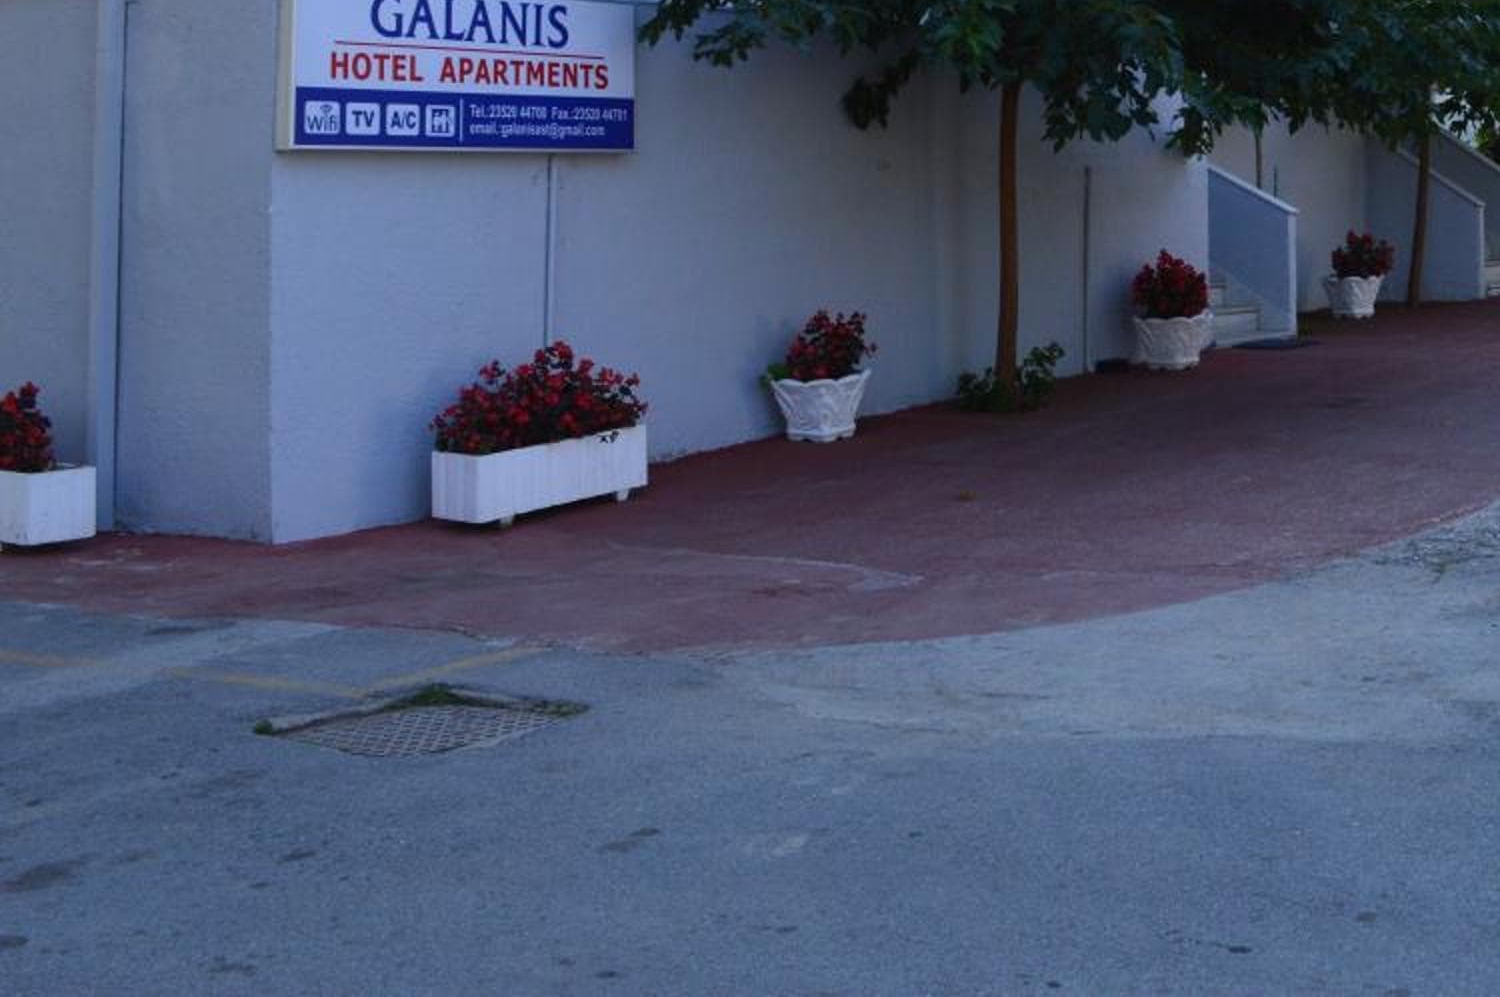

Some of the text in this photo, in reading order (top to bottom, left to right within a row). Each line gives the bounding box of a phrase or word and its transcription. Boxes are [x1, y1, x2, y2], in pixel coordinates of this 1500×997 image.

[330, 52, 609, 90] HOTEL APARTMENTS
[352, 110, 375, 128] TV
[390, 110, 417, 129] A/C
